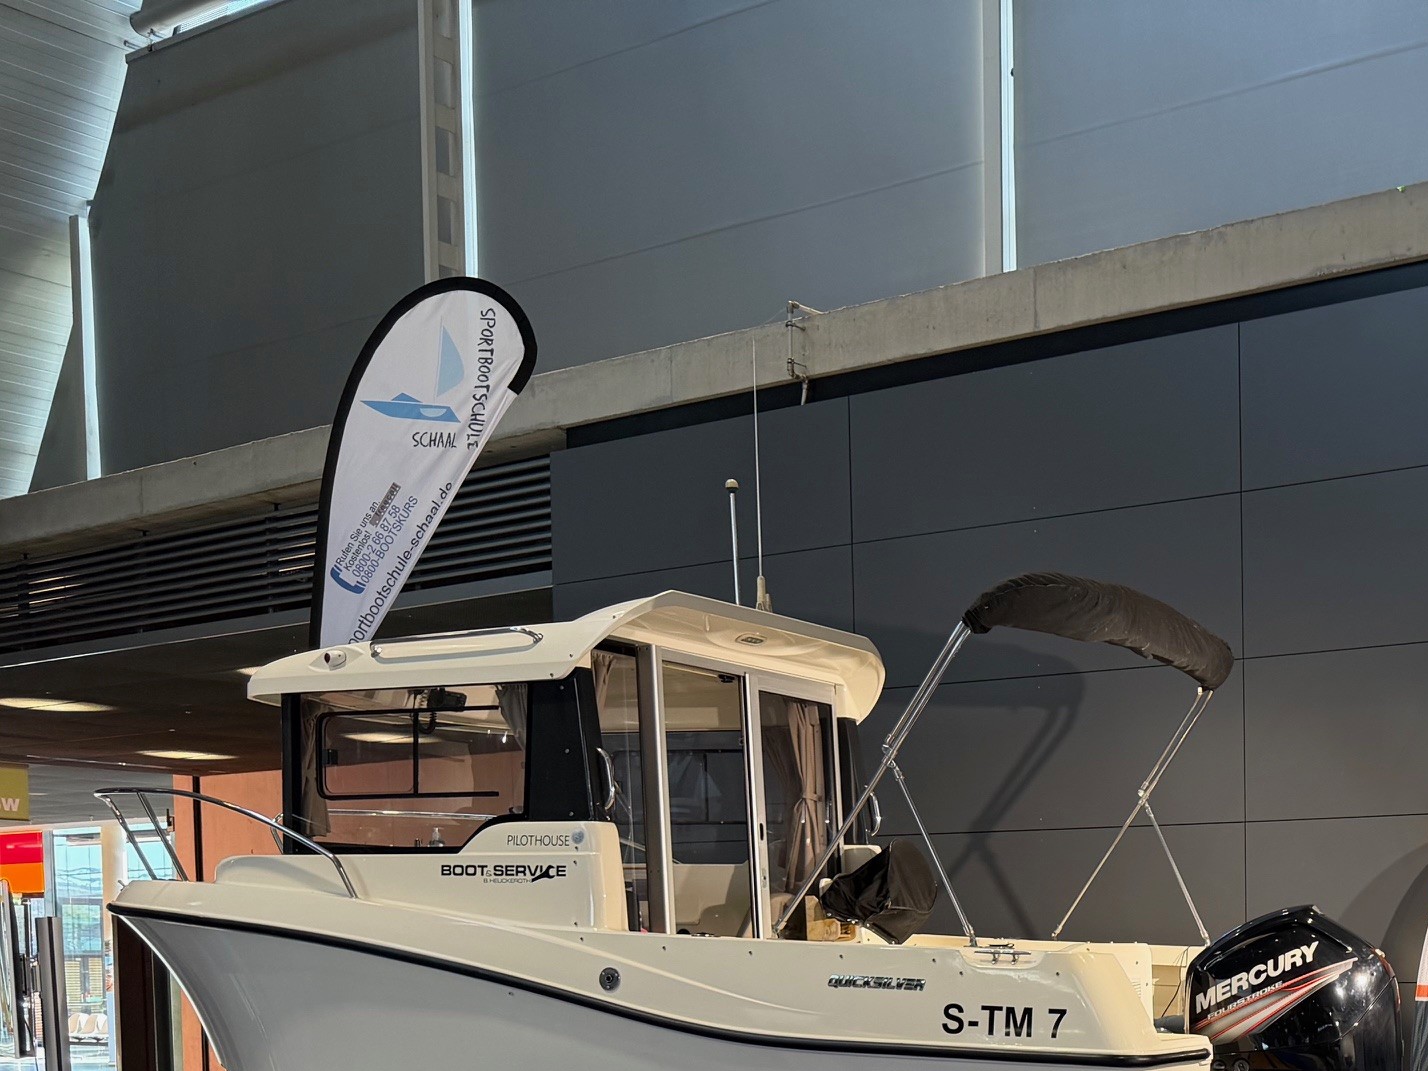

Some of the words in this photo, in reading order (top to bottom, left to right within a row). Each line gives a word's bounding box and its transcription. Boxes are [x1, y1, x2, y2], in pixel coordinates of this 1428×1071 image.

[467, 307, 496, 450] SPORTBOOTSCHULE
[412, 431, 457, 448] SCHAAL
[336, 542, 355, 567] Rufen
[350, 528, 363, 542] Sie
[360, 513, 373, 529] uns
[343, 530, 373, 572] Kostenlos!
[352, 544, 375, 578] 0800-2
[371, 531, 384, 546] 66
[380, 517, 392, 532] 87
[388, 504, 401, 520] 58
[360, 495, 418, 584] 0800-BOOTSKURS
[507, 834, 570, 847] PILOTHOUSE
[828, 974, 926, 991] QUICKSILVER
[1195, 941, 1319, 1014] MERCURY
[942, 1003, 1033, 1037] S-TM
[1048, 1008, 1067, 1038] 7
[1207, 980, 1283, 1020] FOURSTROKE
